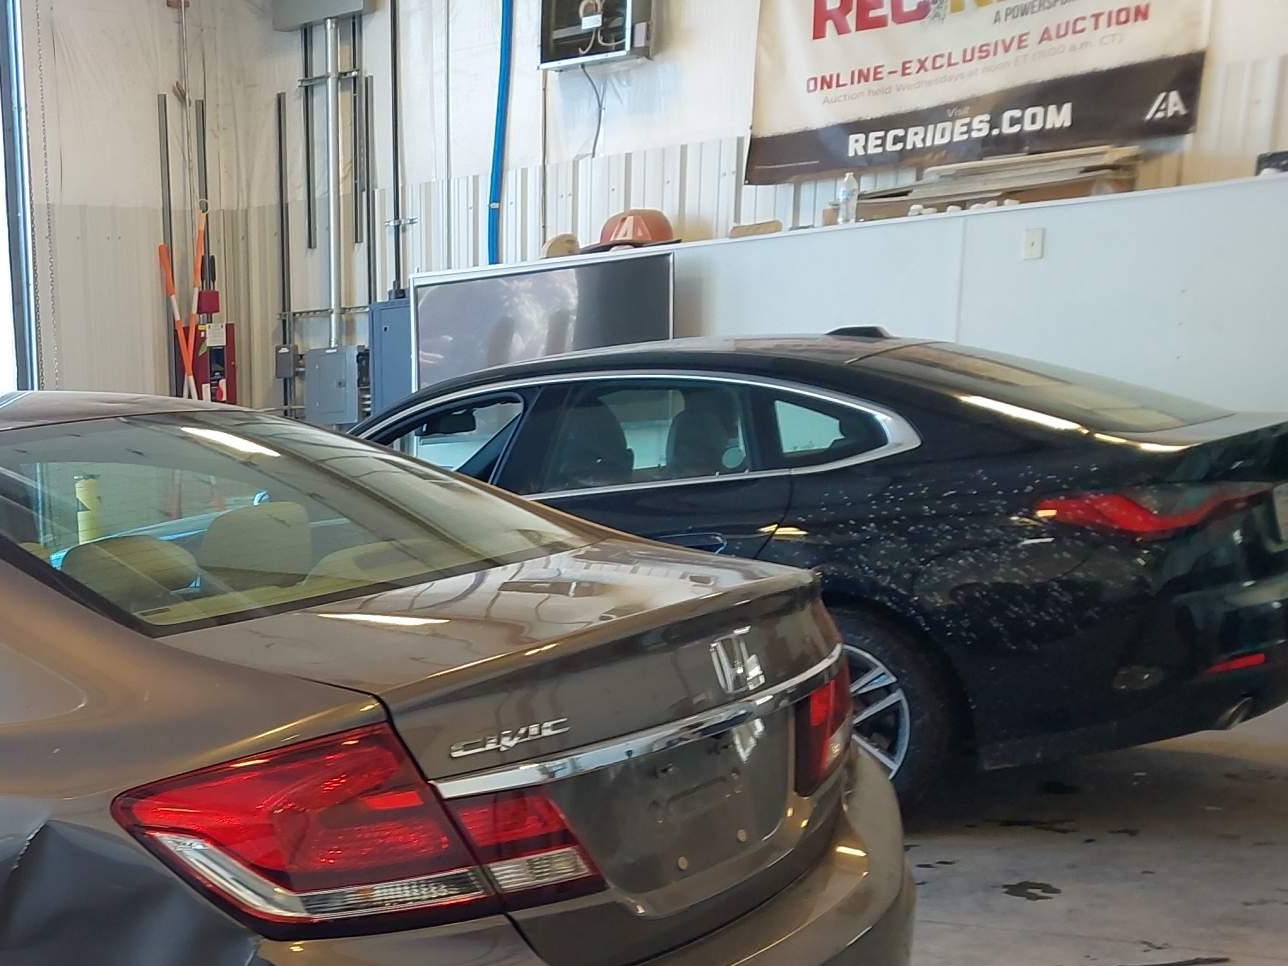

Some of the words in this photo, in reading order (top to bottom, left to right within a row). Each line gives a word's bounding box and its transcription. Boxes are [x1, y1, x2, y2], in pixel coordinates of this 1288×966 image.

[993, 9, 1001, 24] A
[806, 32, 1030, 93] ONLINE-EXCLUSIVE
[1038, 3, 1151, 45] AUCTION
[848, 102, 1073, 157] RECRIDES.COM
[450, 718, 571, 758] CIVIC
